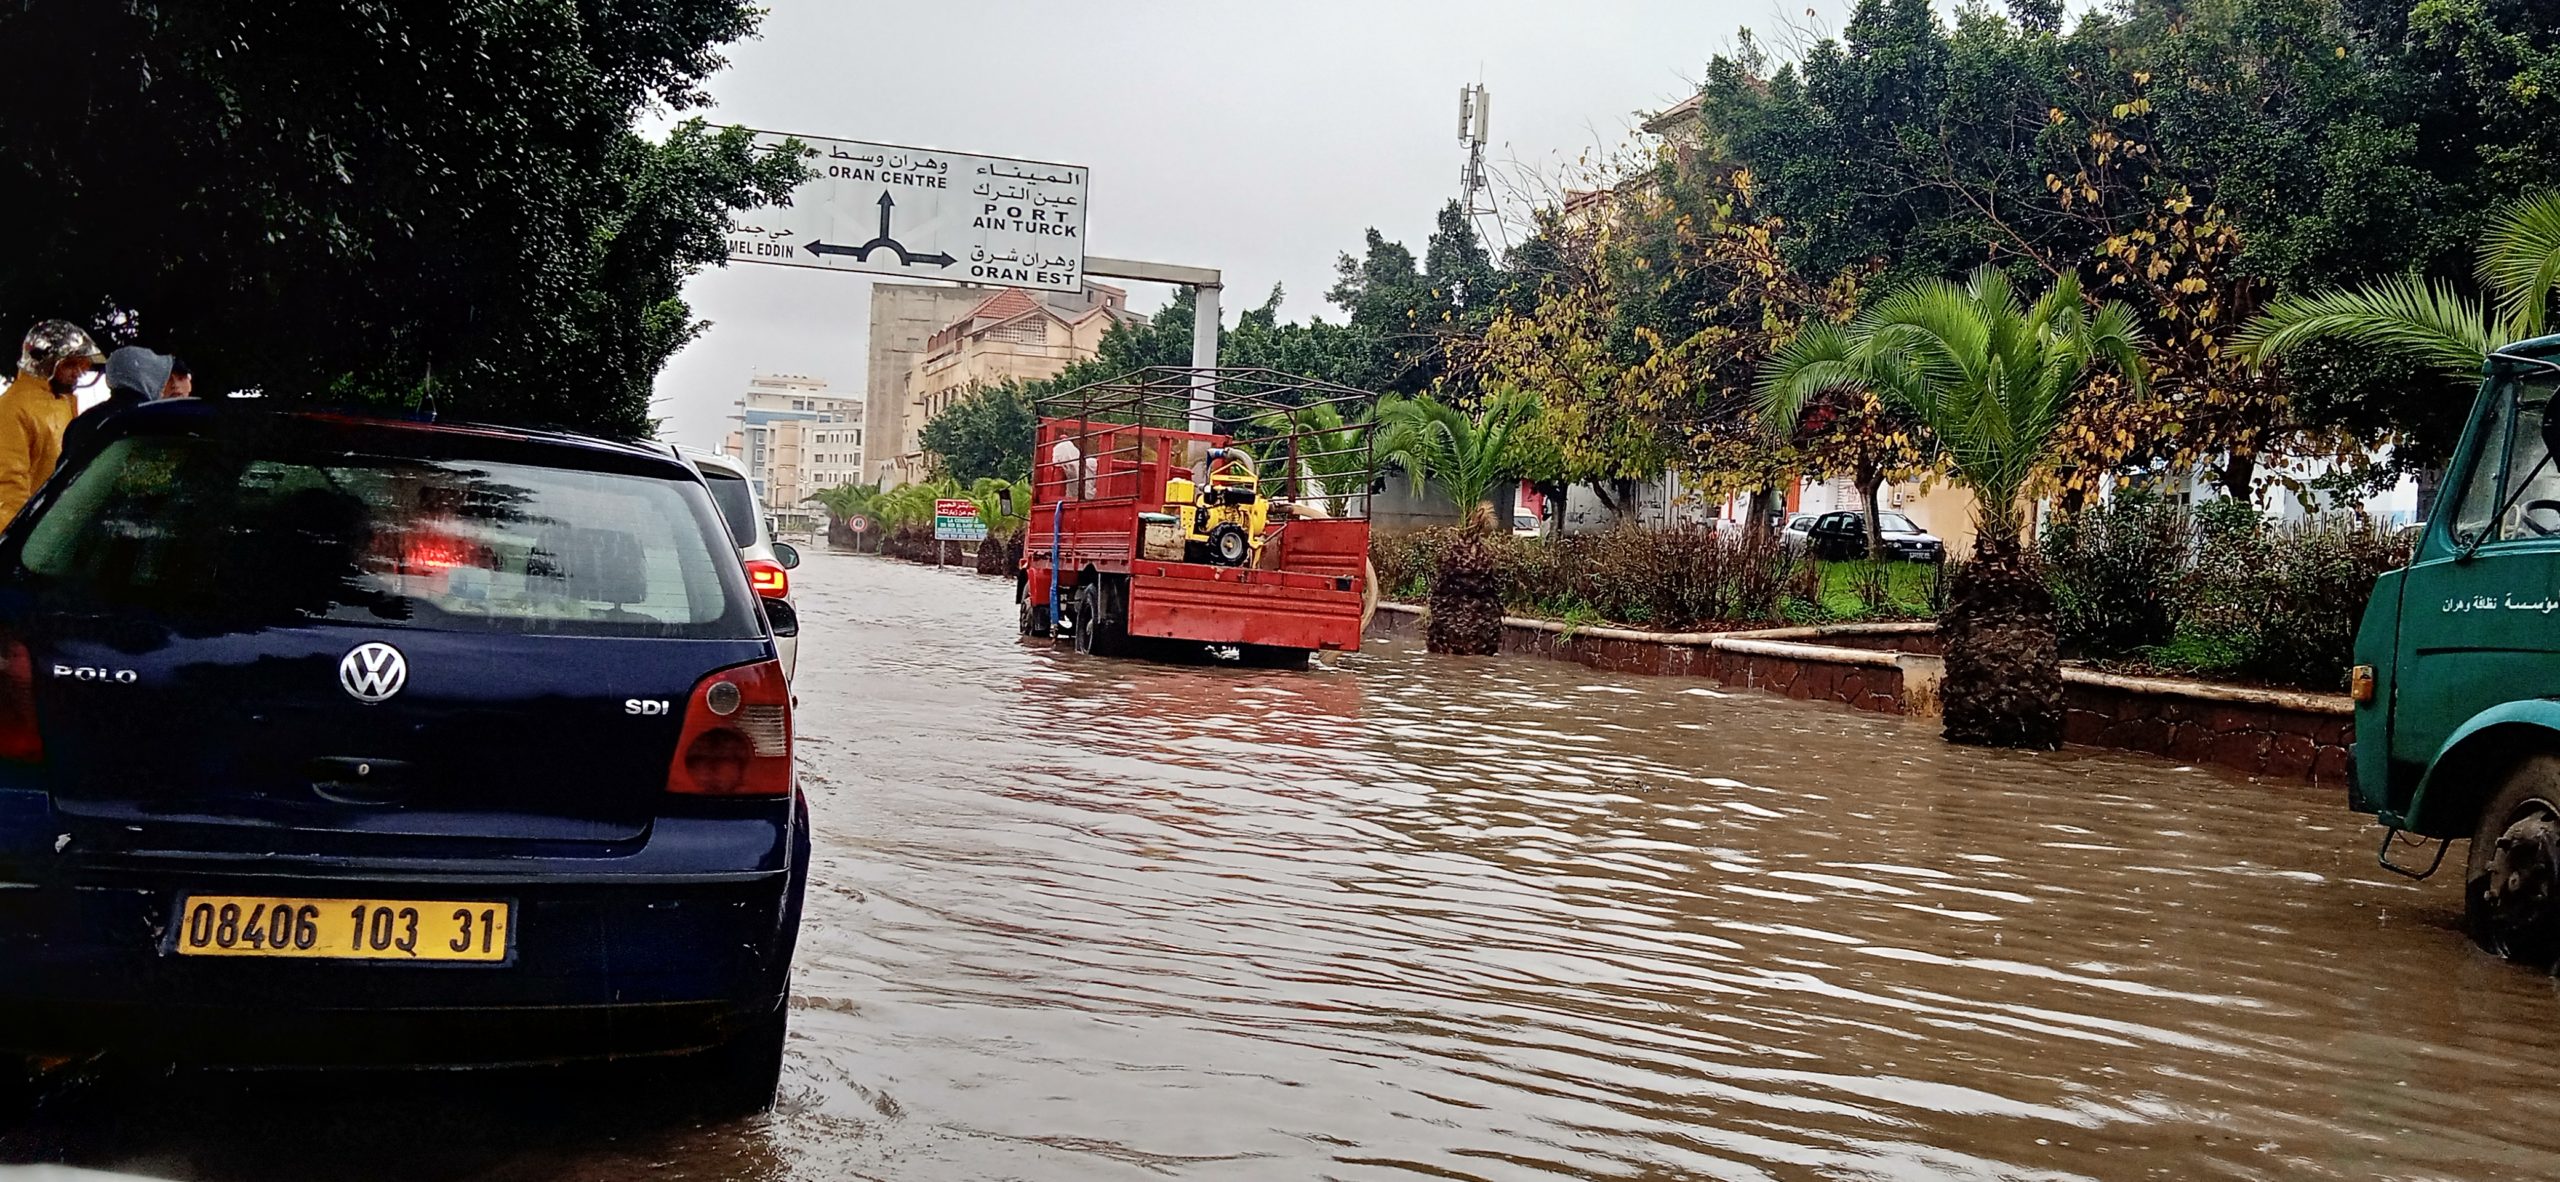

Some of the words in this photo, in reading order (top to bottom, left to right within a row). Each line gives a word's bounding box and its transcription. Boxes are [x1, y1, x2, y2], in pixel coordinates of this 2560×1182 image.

[828, 145, 884, 167] وسط
[888, 154, 948, 175] وهران
[828, 165, 875, 181] ORAN
[881, 171, 947, 189] CENTRE
[973, 183, 1029, 201] الترك
[1033, 192, 1078, 208] عين
[984, 204, 1068, 222] PORT
[768, 229, 794, 243] حي
[973, 217, 1006, 230] AIN
[1012, 220, 1077, 238] TURCK
[729, 240, 753, 255] MEL
[757, 243, 794, 258] EDDIN
[970, 244, 1018, 264] شرق
[1022, 252, 1075, 271] وهران
[970, 265, 1028, 281] ORAN
[1036, 271, 1075, 285] EST
[2442, 598, 2471, 613] وهران
[2472, 595, 2498, 610] نظافة
[2504, 592, 2559, 614] مؤسسة
[53, 664, 138, 684] POLO
[625, 698, 670, 715] SDI
[189, 902, 320, 950] 08406
[351, 904, 419, 955] 103
[449, 908, 495, 954] 31
